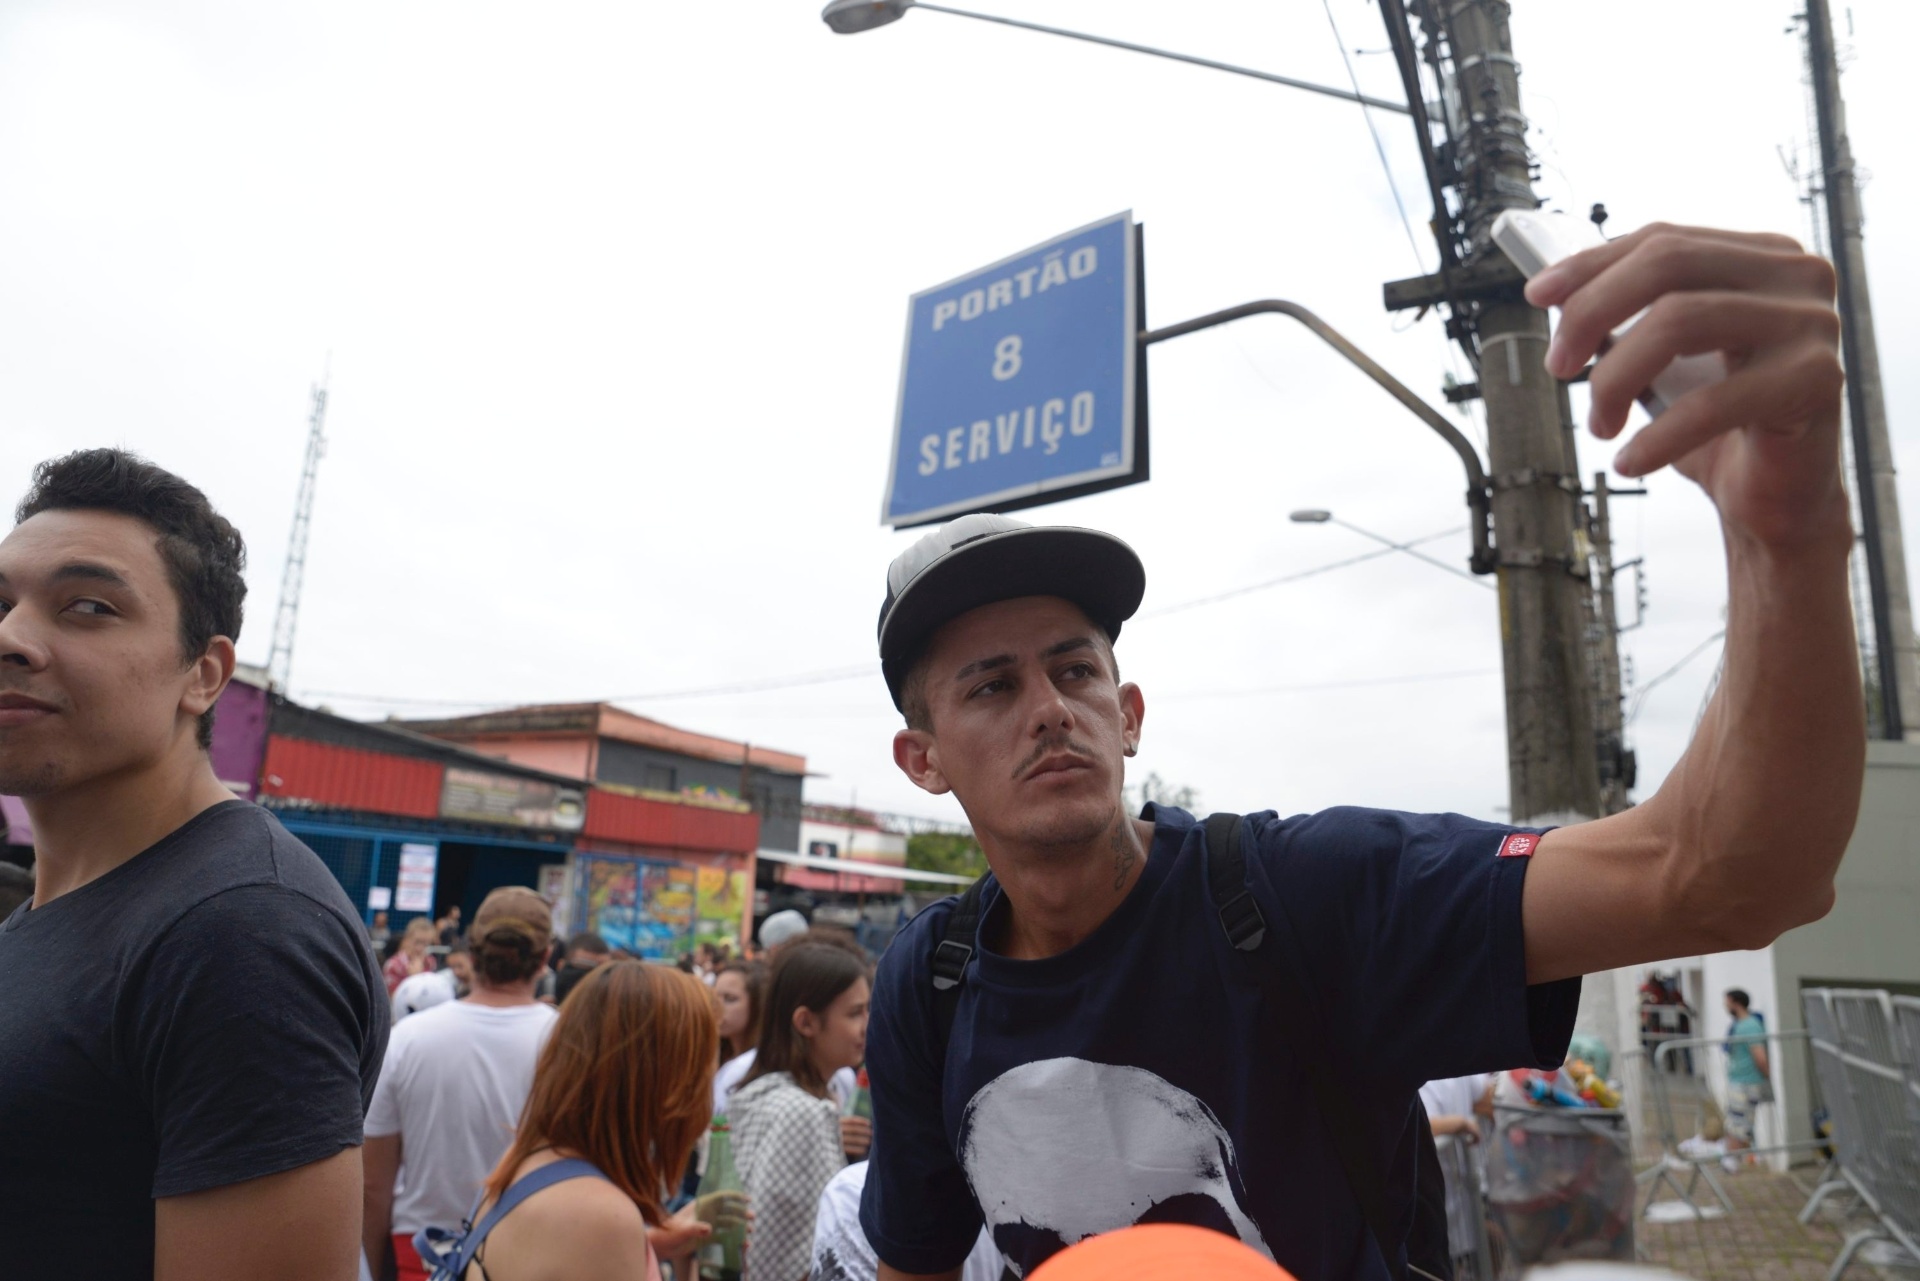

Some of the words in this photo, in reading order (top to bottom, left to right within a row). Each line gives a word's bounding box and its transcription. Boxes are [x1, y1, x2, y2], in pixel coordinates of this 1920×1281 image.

[932, 245, 1098, 331] PORTÃO
[992, 334, 1023, 381] 8
[918, 391, 1095, 476] SERVIÇO
